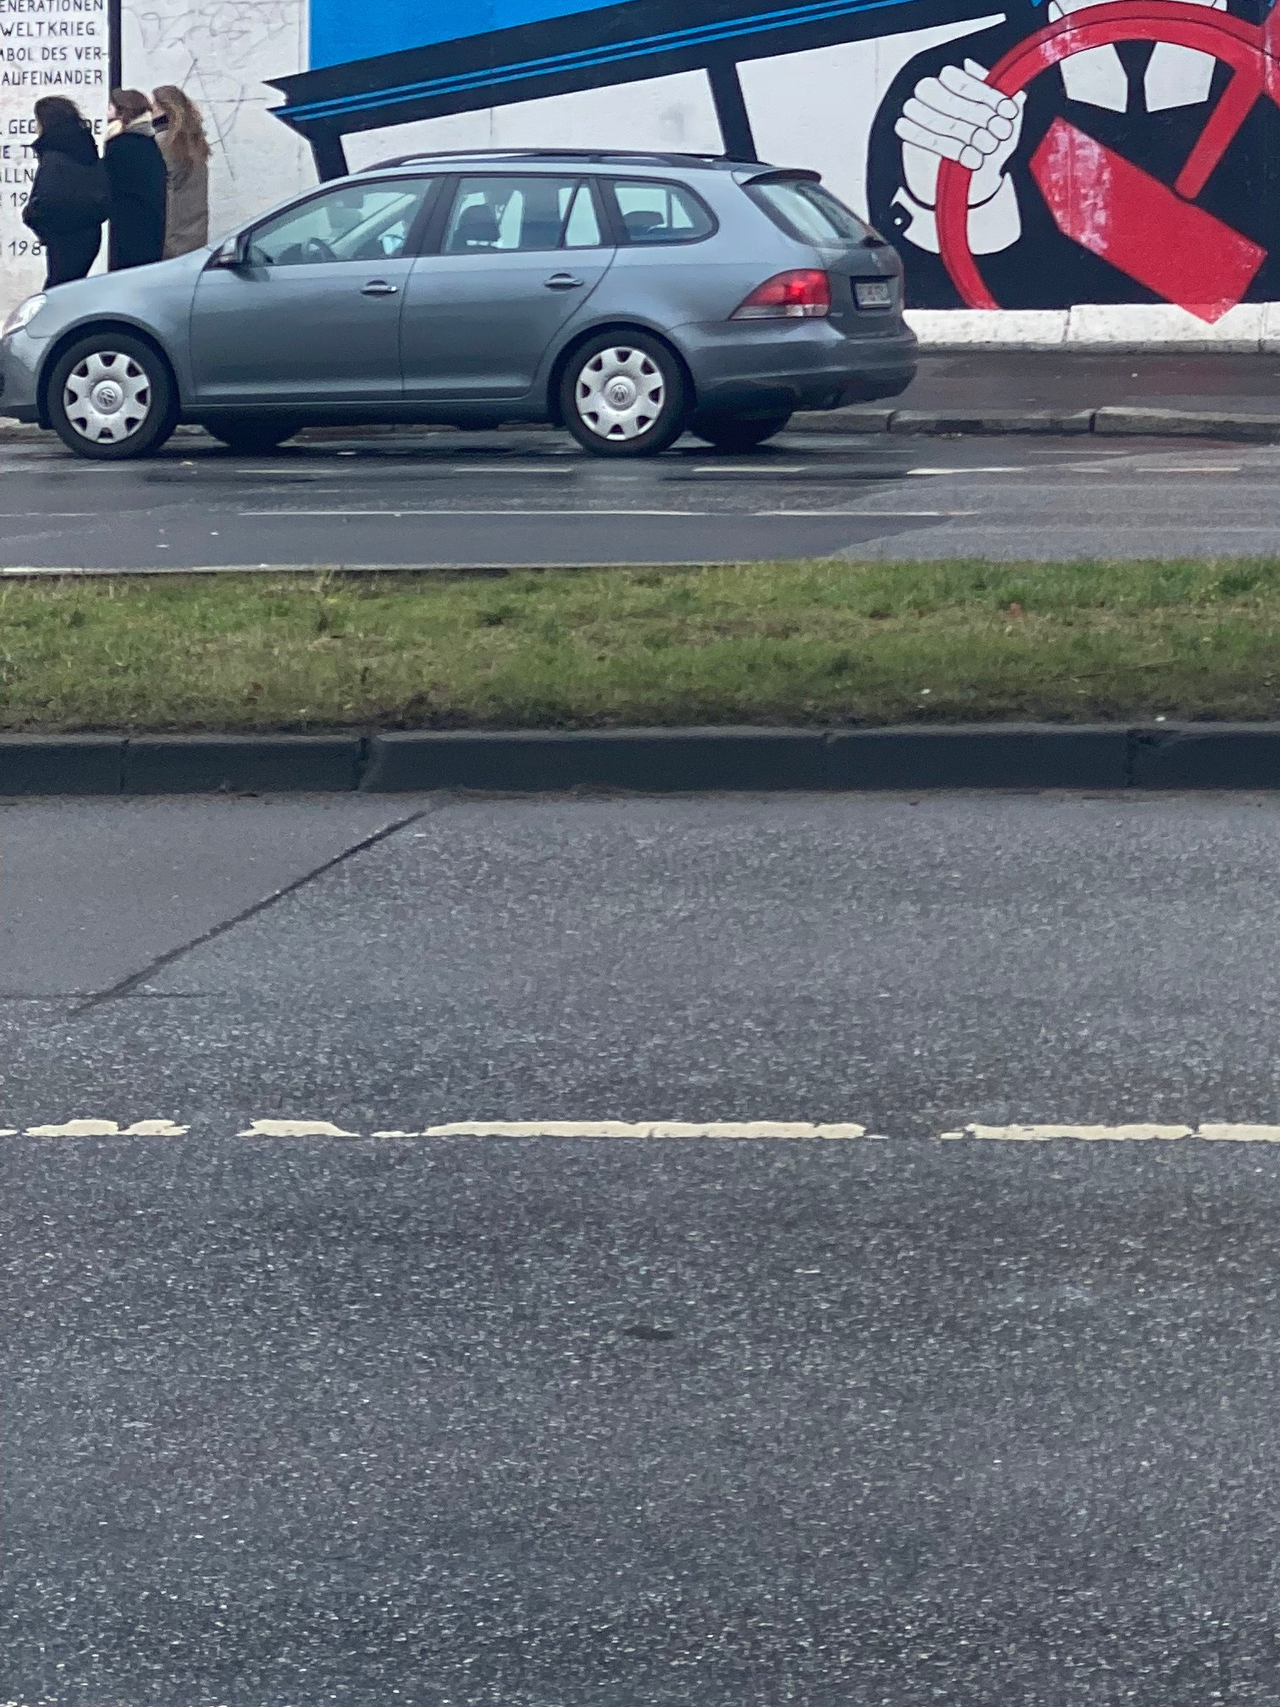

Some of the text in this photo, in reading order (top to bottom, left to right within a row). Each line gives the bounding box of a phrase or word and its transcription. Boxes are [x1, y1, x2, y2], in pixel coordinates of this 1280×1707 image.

[0, 21, 95, 37] WELTKRIEG
[41, 46, 68, 61] DES
[74, 46, 108, 61] VER-
[2, 69, 104, 86] AUFEINANDER
[0, 168, 35, 184] LLN
[8, 240, 42, 256] 198
